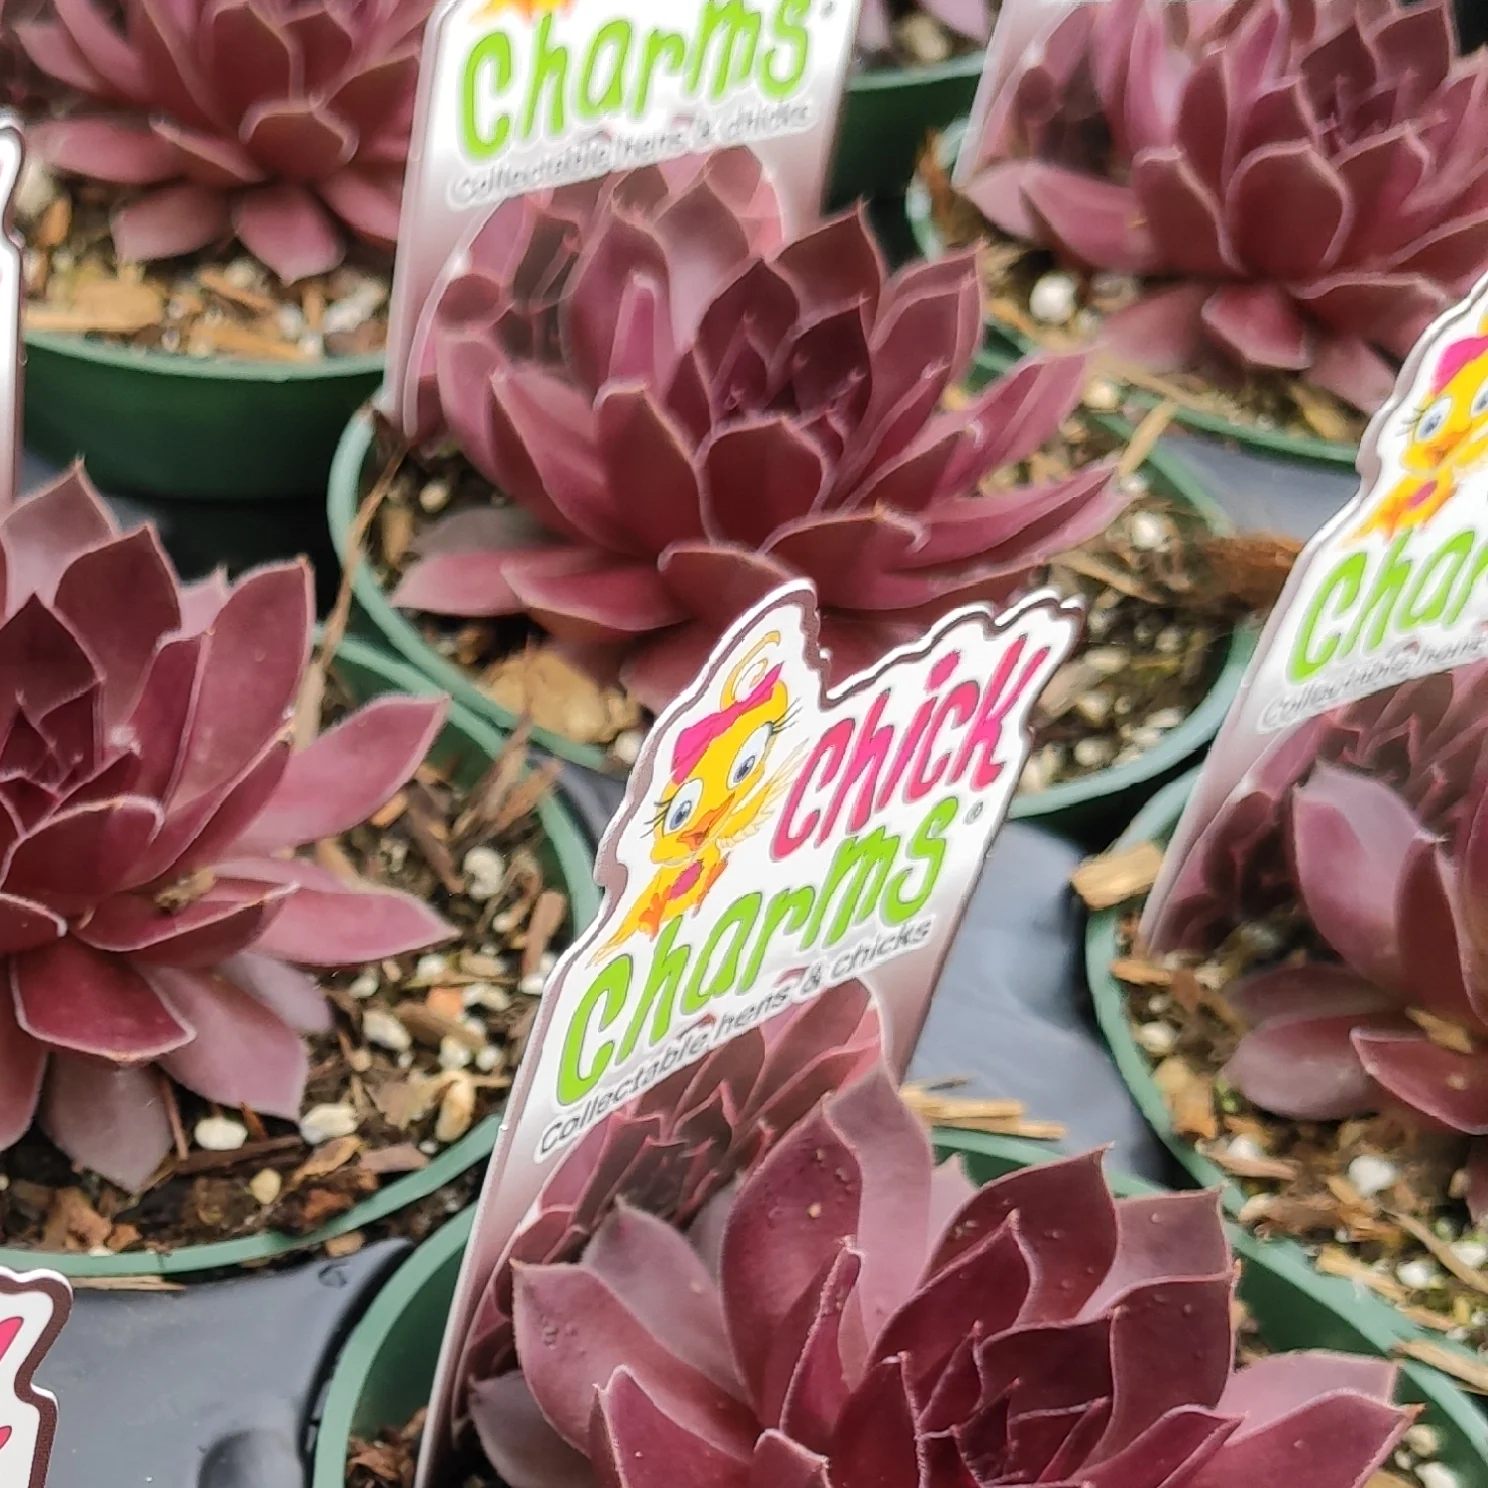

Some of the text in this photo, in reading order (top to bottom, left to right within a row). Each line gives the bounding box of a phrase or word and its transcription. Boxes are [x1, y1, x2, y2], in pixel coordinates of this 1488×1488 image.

[1290, 526, 1488, 682] Char
[773, 636, 1049, 861] Chick
[540, 1026, 710, 1155] Collectable
[718, 990, 791, 1037] hens
[831, 918, 931, 979] chicks
[557, 797, 959, 1104] Charms
